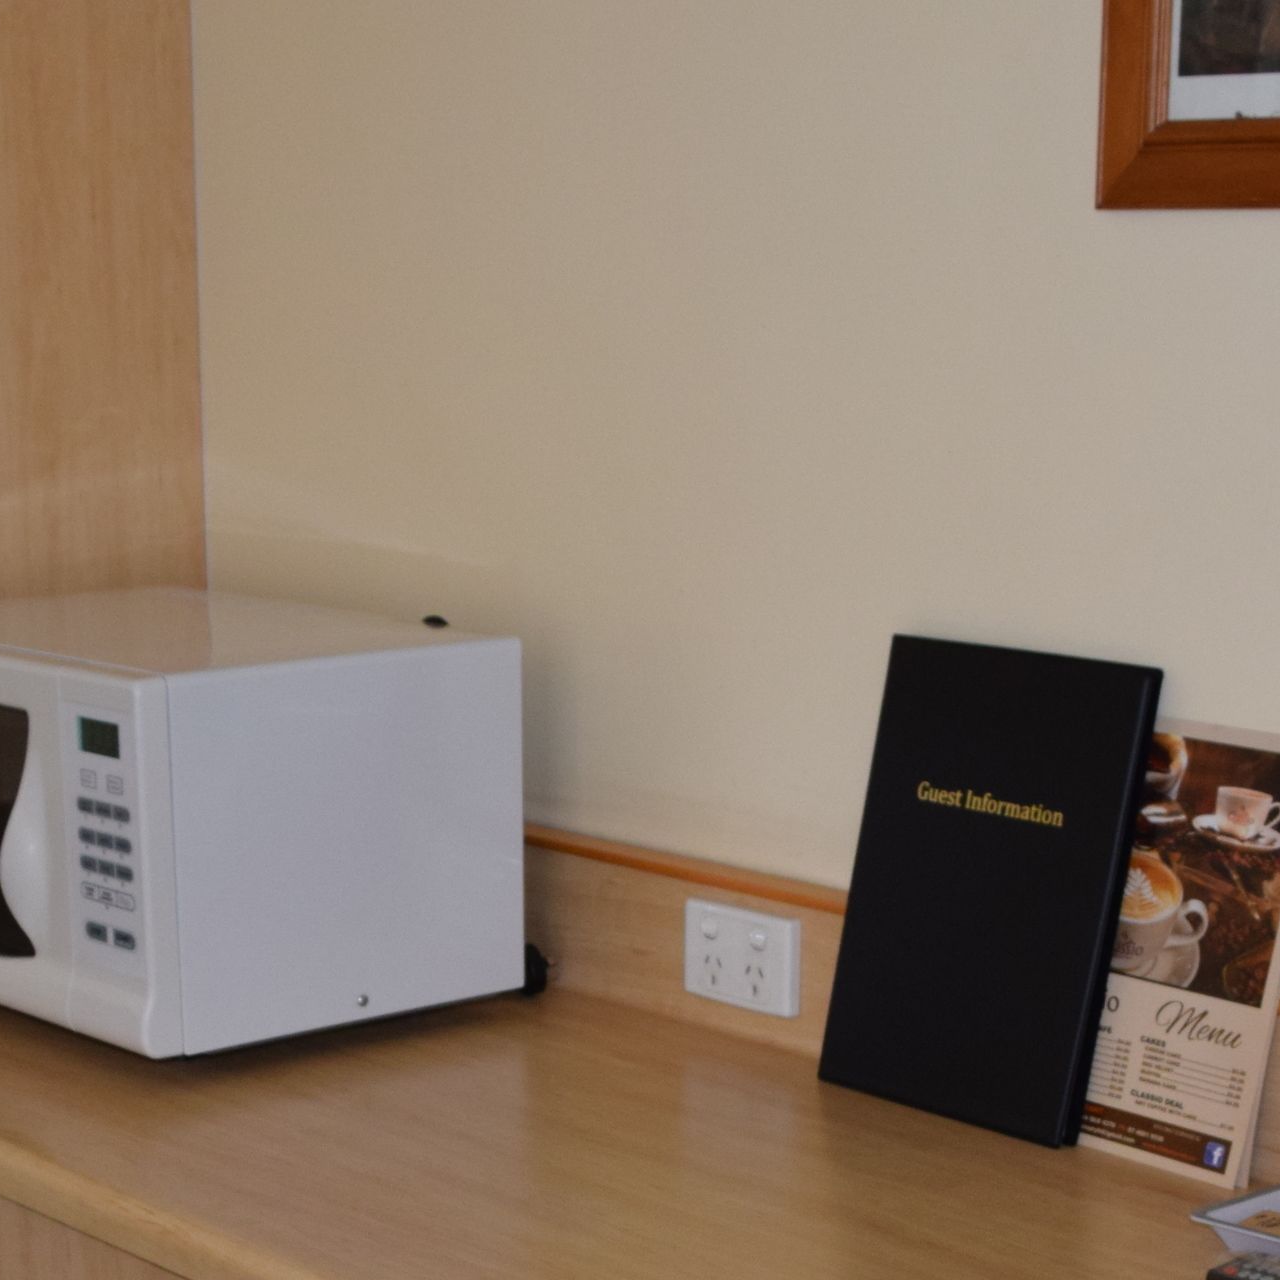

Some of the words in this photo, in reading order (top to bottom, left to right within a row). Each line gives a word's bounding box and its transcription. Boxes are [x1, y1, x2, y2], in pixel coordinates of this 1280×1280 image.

[917, 780, 963, 807] Guest
[965, 789, 1064, 827] Information
[1155, 999, 1242, 1049] Menu
